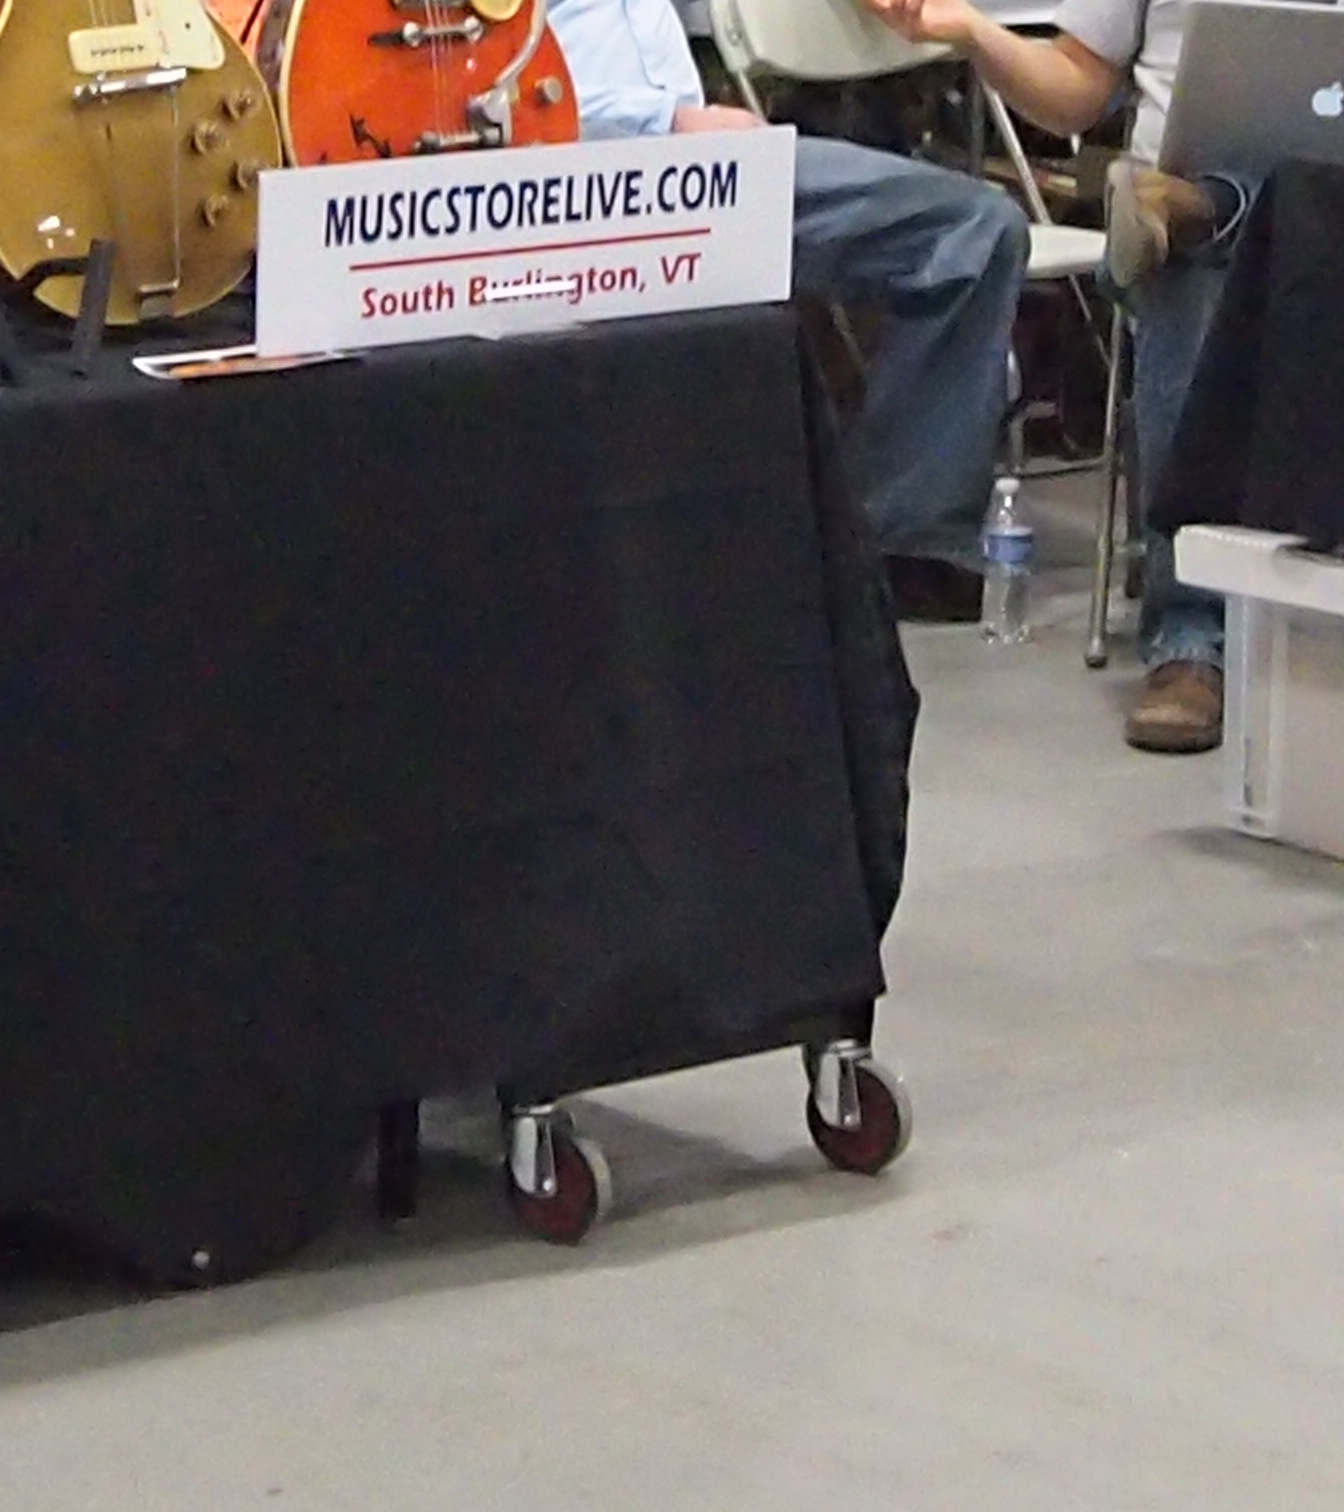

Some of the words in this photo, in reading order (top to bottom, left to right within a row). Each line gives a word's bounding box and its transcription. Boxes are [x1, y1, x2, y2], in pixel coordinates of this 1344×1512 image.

[324, 161, 738, 247] MUSICSTORELIVE.COM
[361, 279, 454, 319] South
[661, 253, 701, 285] VT
